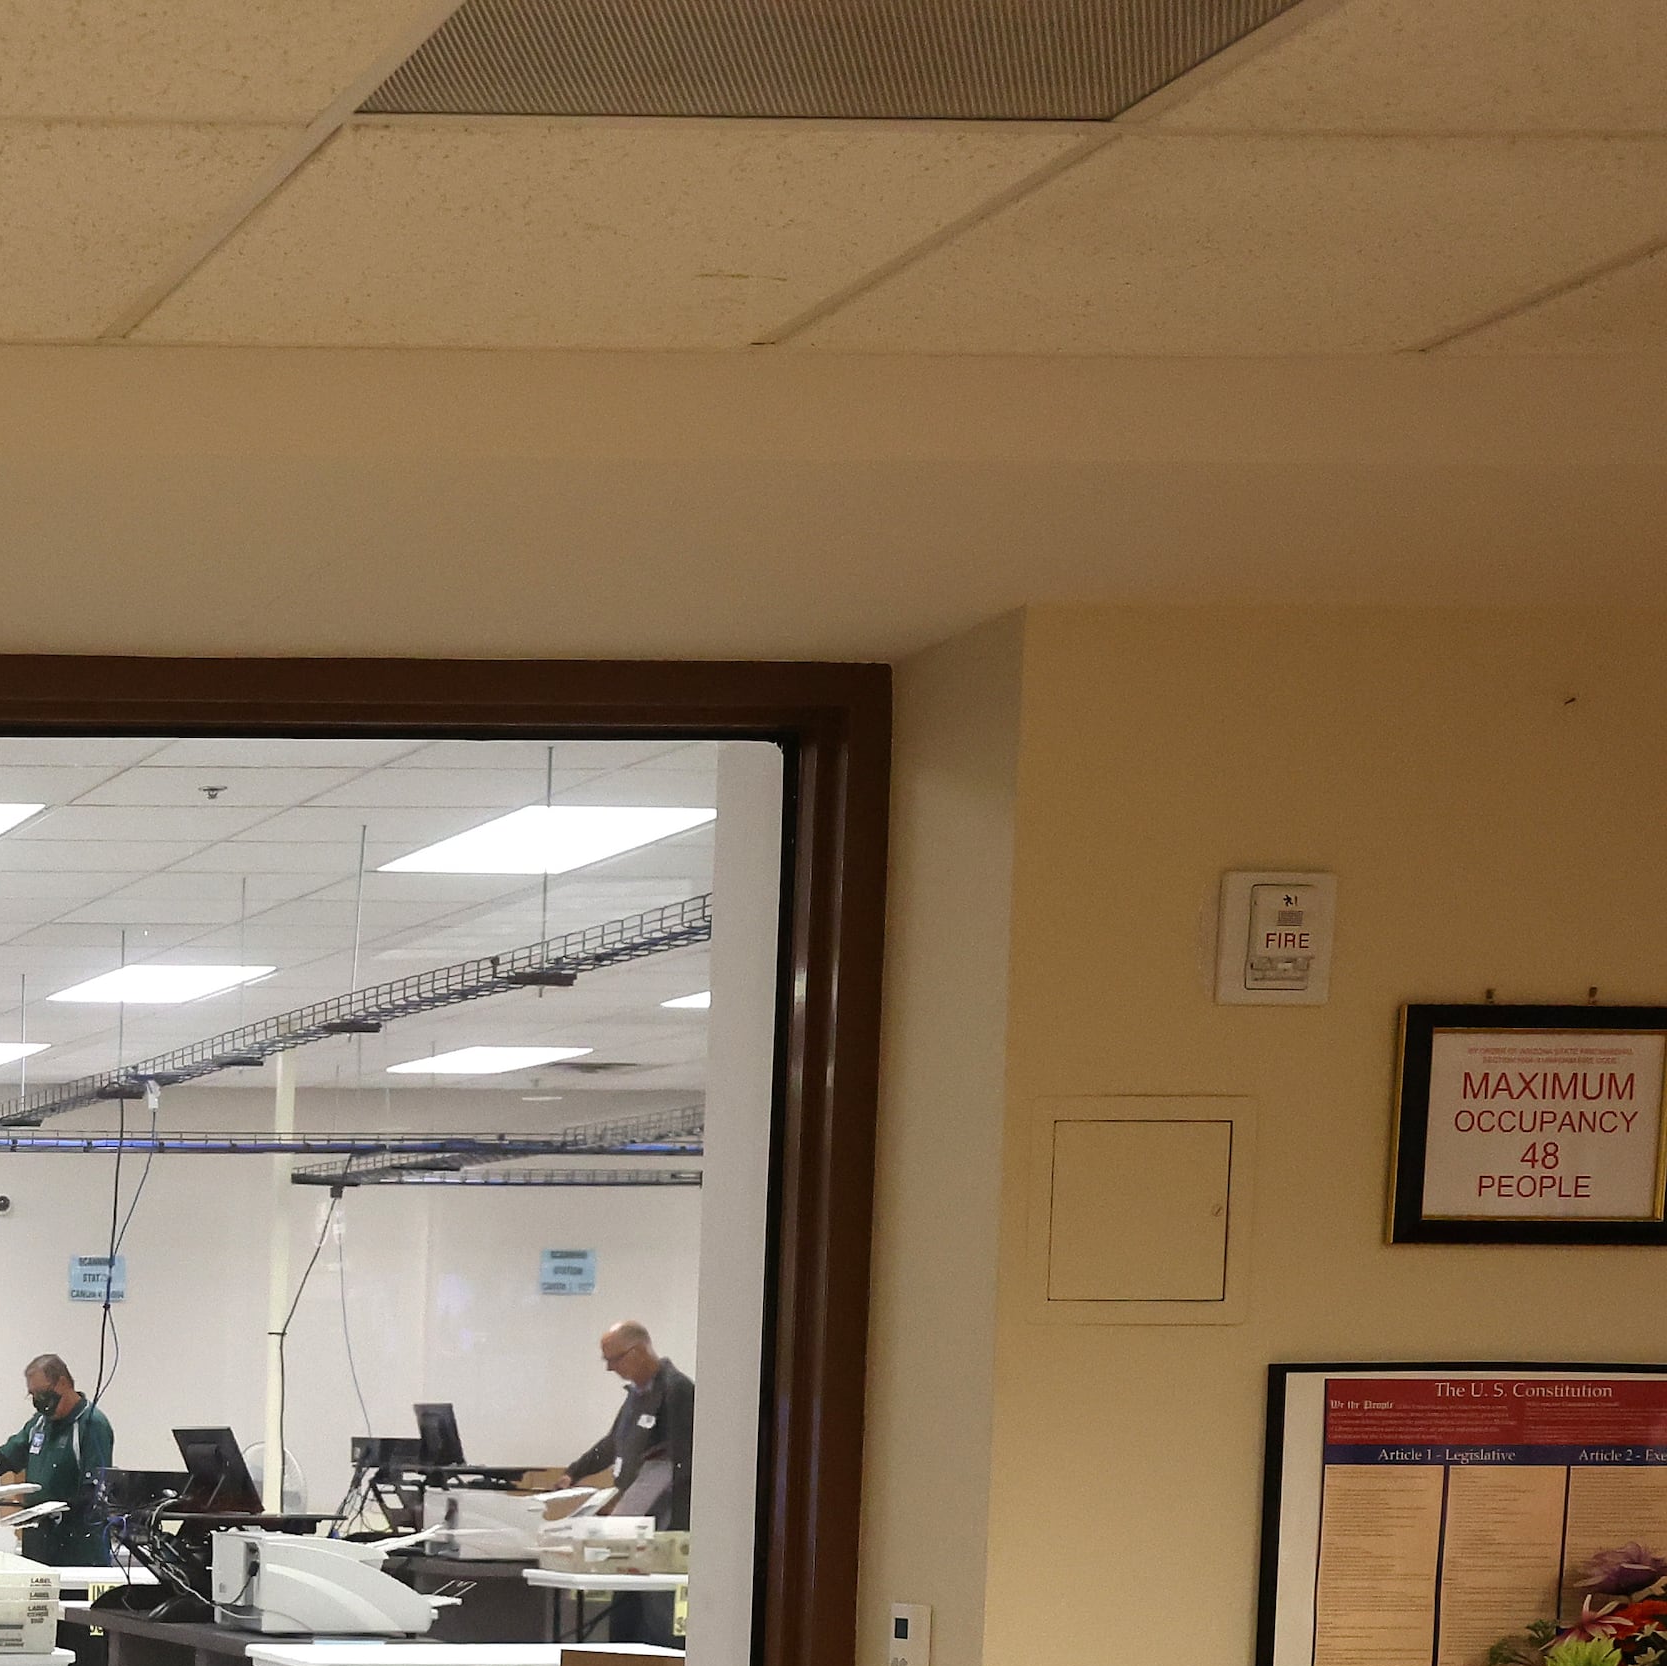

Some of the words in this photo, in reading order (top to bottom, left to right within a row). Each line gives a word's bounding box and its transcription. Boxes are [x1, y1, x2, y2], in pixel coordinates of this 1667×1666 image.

[1265, 932, 1310, 949] FIRE
[1463, 1072, 1635, 1100] MAXIMUM
[1454, 1110, 1638, 1133] OCCUPANCY
[1520, 1141, 1560, 1170] 48
[1478, 1175, 1592, 1198] PEOPLE
[79, 1257, 115, 1266] SCANNIN
[1434, 1382, 1465, 1397] The
[1471, 1382, 1488, 1397] U.
[1493, 1383, 1508, 1397] S.
[1513, 1383, 1612, 1397] Constitution
[1378, 1448, 1422, 1461] Article
[1427, 1448, 1431, 1461] 1
[1446, 1448, 1516, 1464] Legislative
[1579, 1449, 1622, 1462] Article
[1626, 1449, 1632, 1462] 2
